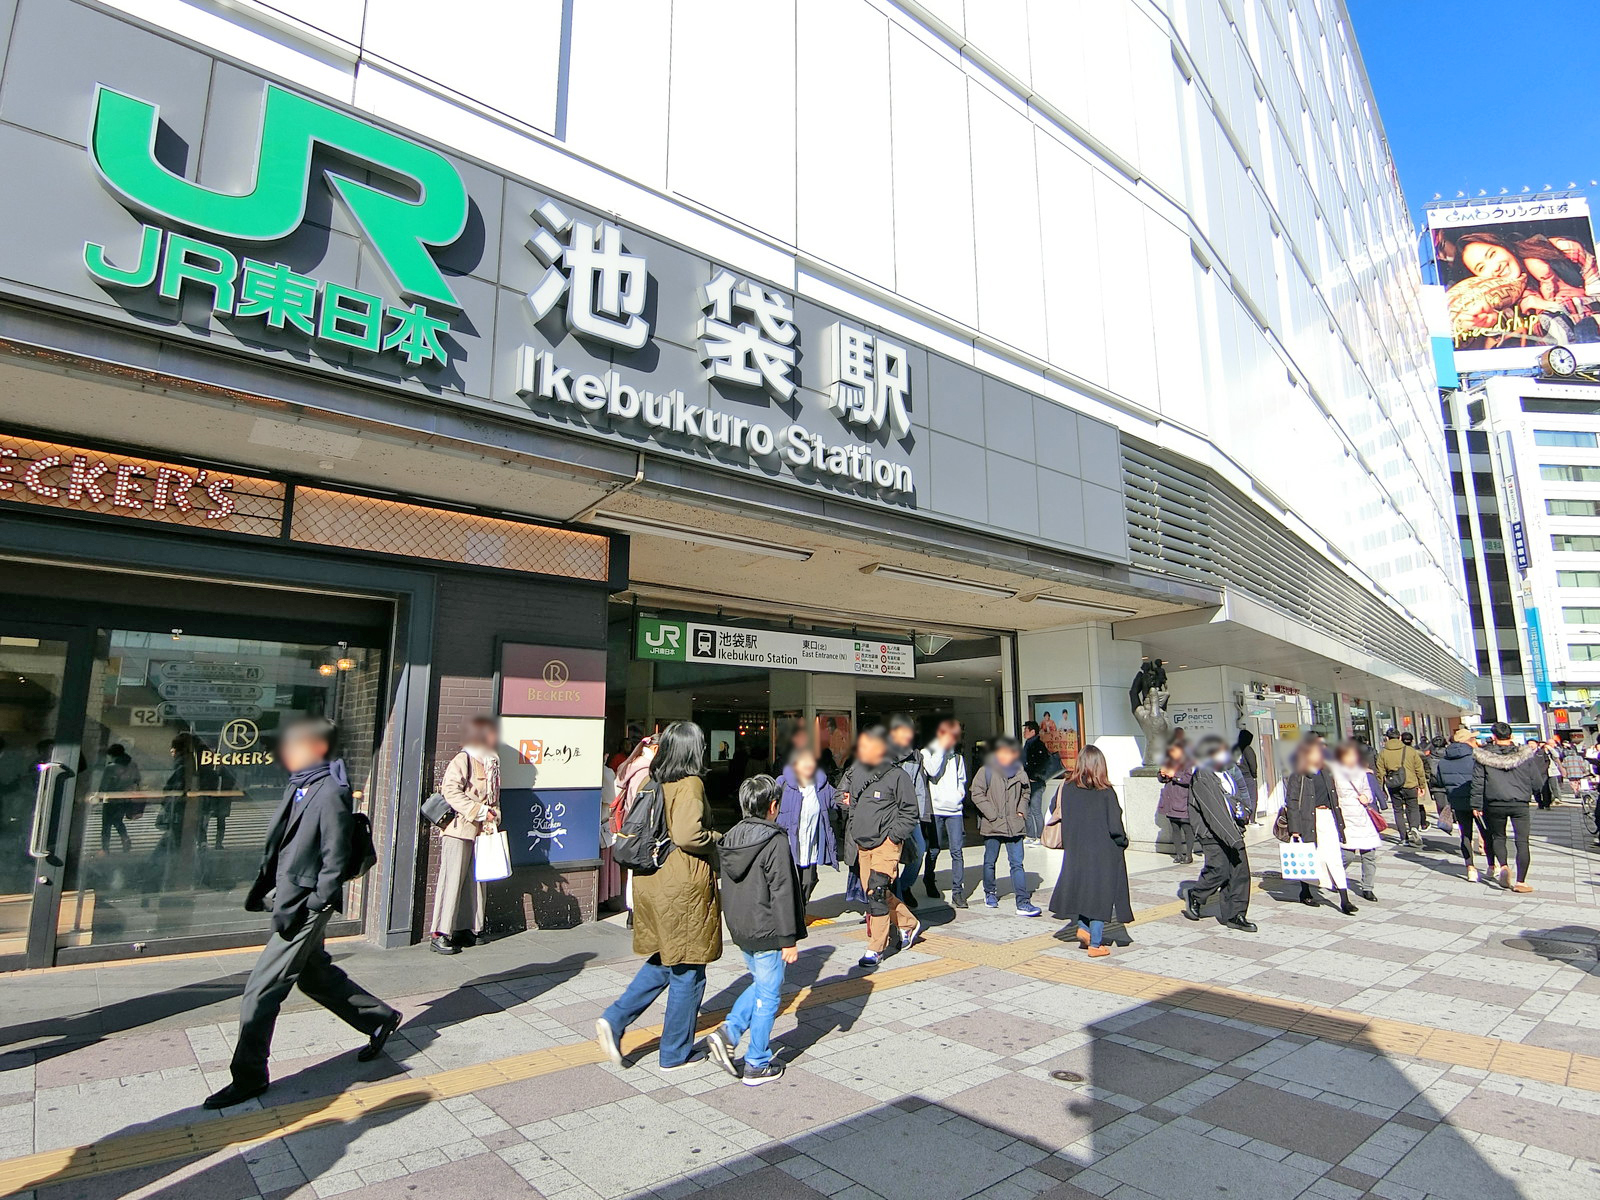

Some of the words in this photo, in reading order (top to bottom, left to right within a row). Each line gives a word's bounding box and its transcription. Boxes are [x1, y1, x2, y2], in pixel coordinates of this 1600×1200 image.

[88, 81, 470, 312] JR
[82, 224, 452, 368] JR東日本
[525, 198, 911, 439] 池袋駅
[1453, 306, 1539, 348] friendship
[515, 343, 775, 456] Ikebukuro
[779, 423, 915, 494] Station
[646, 625, 680, 648] JR
[719, 632, 757, 649] 池袋駅
[718, 648, 764, 663] Ikebukuro
[767, 652, 798, 666] Station
[802, 650, 814, 658] East
[815, 651, 839, 660] Entrance
[528, 688, 581, 702] BECKER'S
[201, 750, 274, 766] BECKER'S
